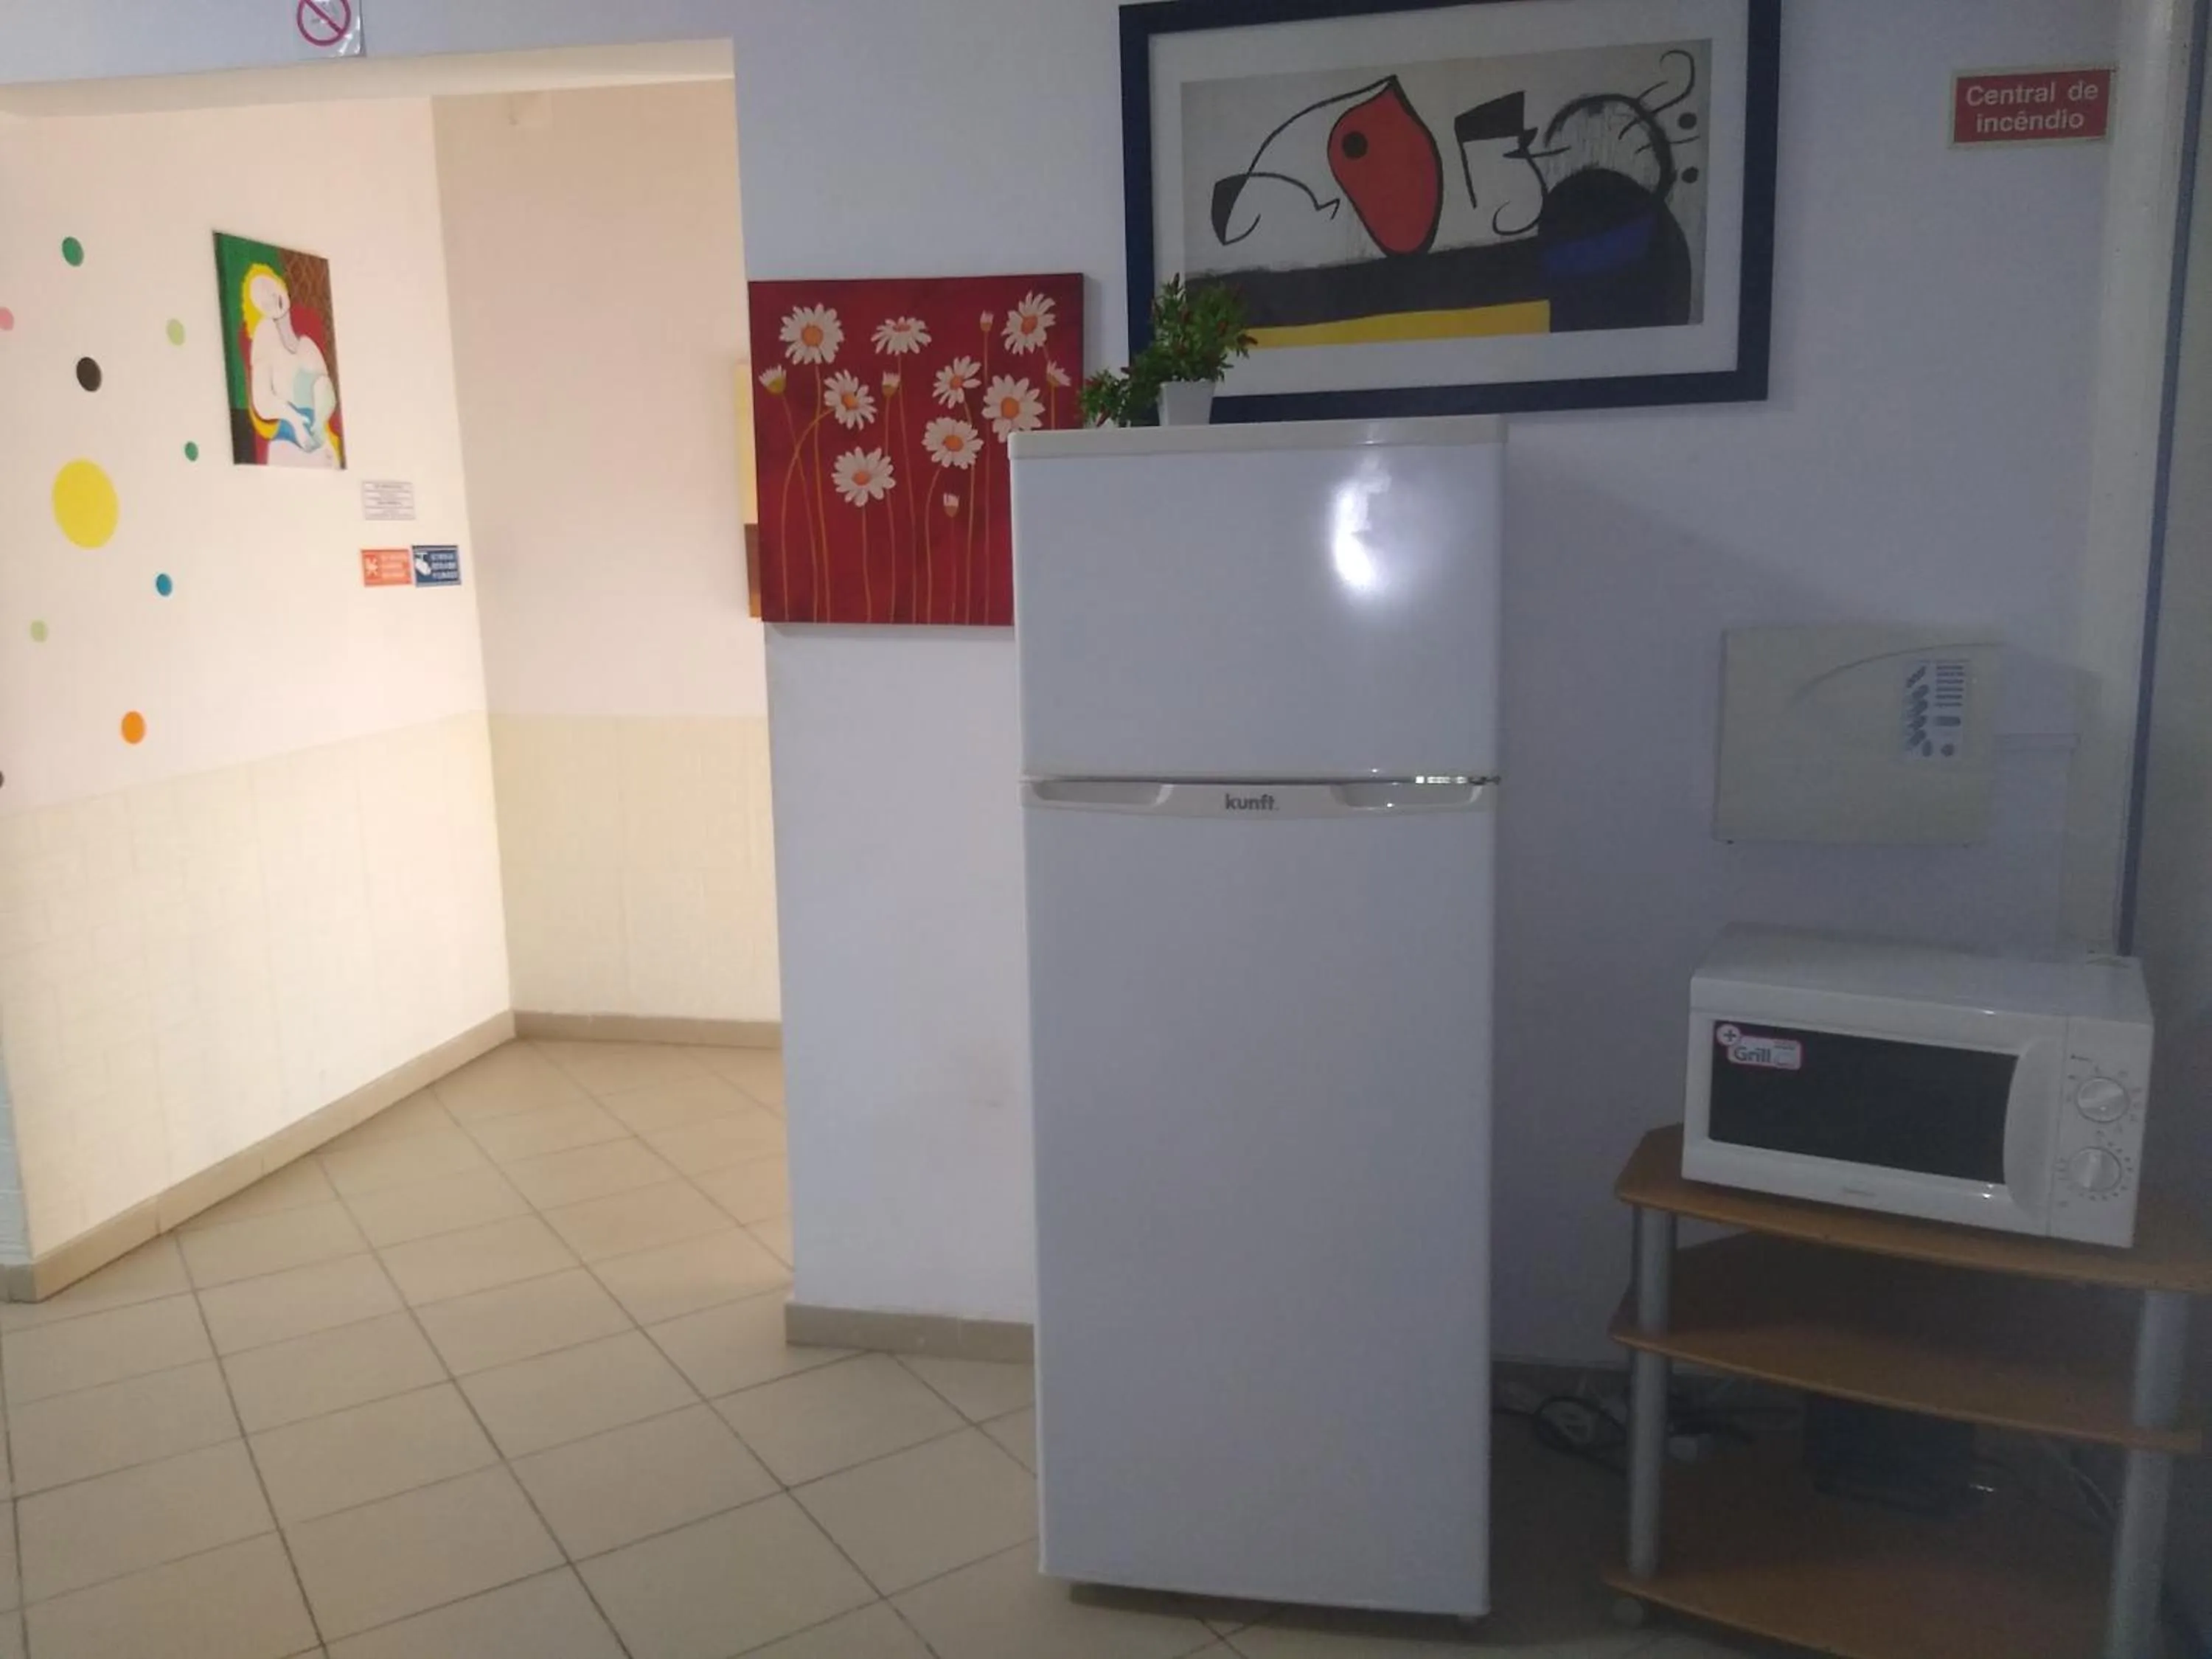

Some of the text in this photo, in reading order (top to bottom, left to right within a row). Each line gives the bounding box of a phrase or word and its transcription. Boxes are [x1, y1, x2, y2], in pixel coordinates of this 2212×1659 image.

[1966, 80, 2098, 106] Central de
[1976, 109, 2085, 133] incêndio
[1225, 793, 1275, 810] kunft
[1734, 1046, 1771, 1062] Grill
